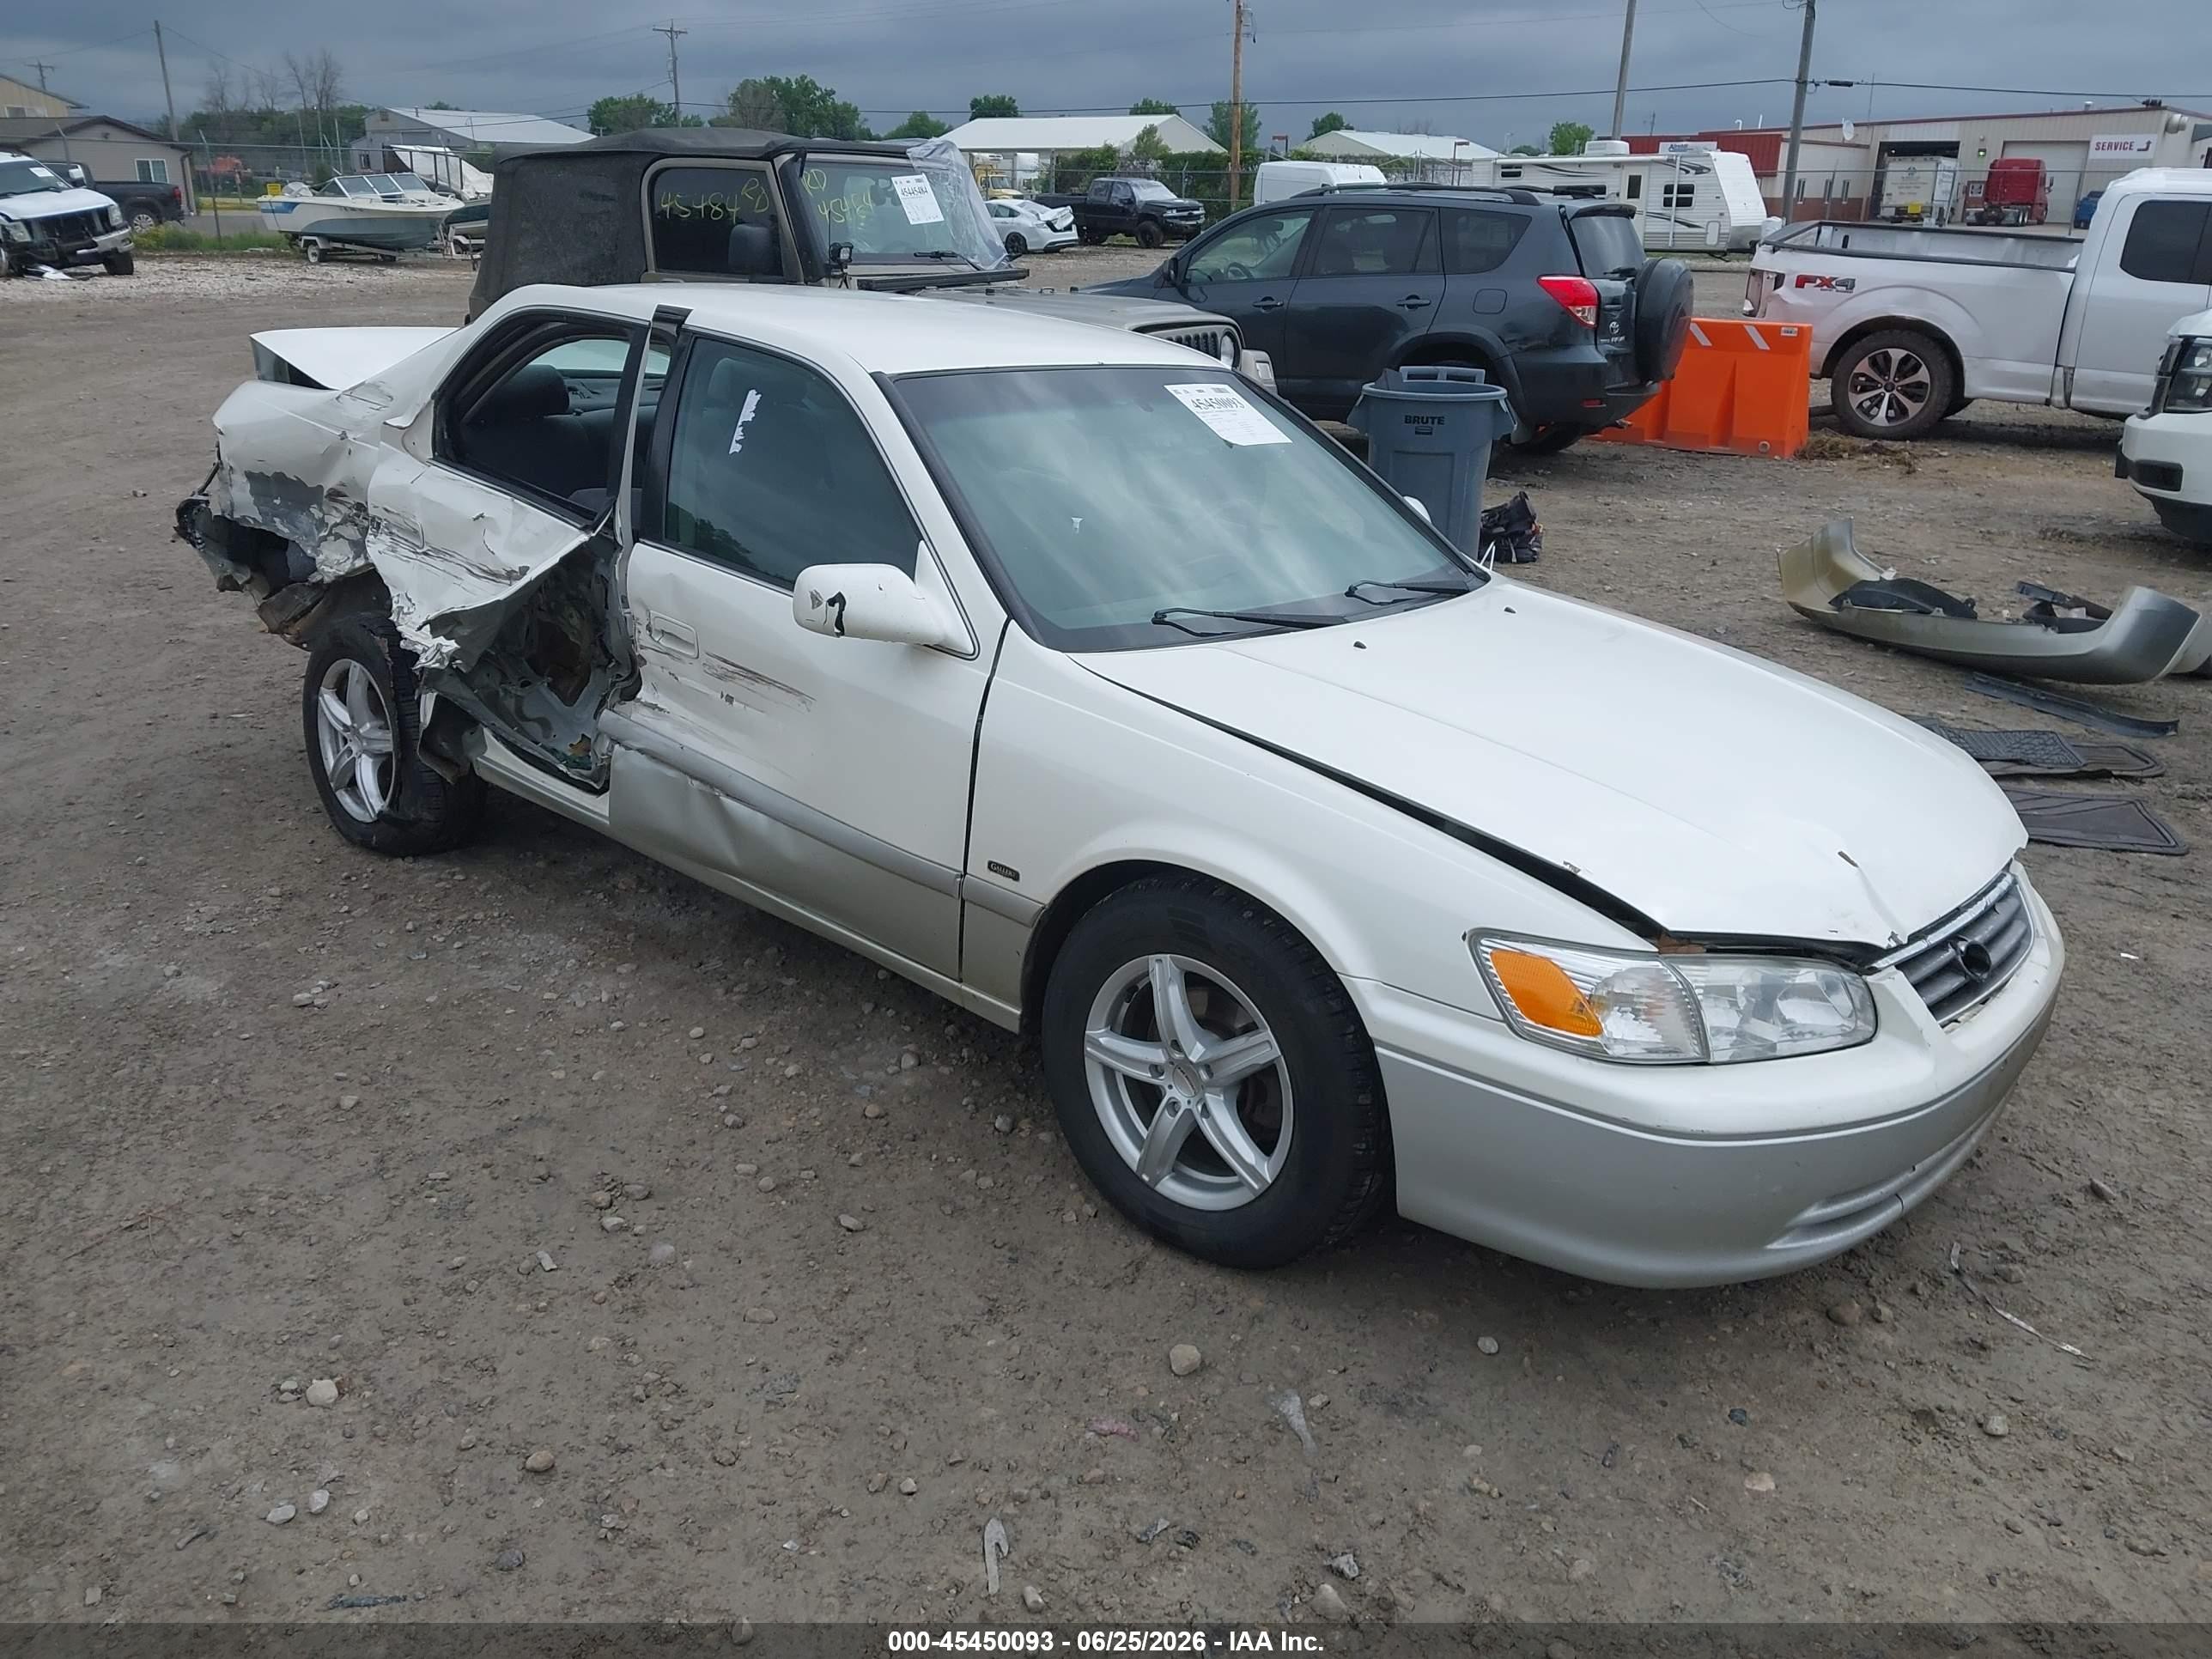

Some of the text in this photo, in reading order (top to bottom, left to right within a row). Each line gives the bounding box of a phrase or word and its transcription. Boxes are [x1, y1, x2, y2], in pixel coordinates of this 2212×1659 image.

[2094, 141, 2135, 151] SERVICE
[1795, 274, 1856, 290] FX4
[1190, 397, 1245, 410] 45450093
[1404, 415, 1445, 426] BRUTE
